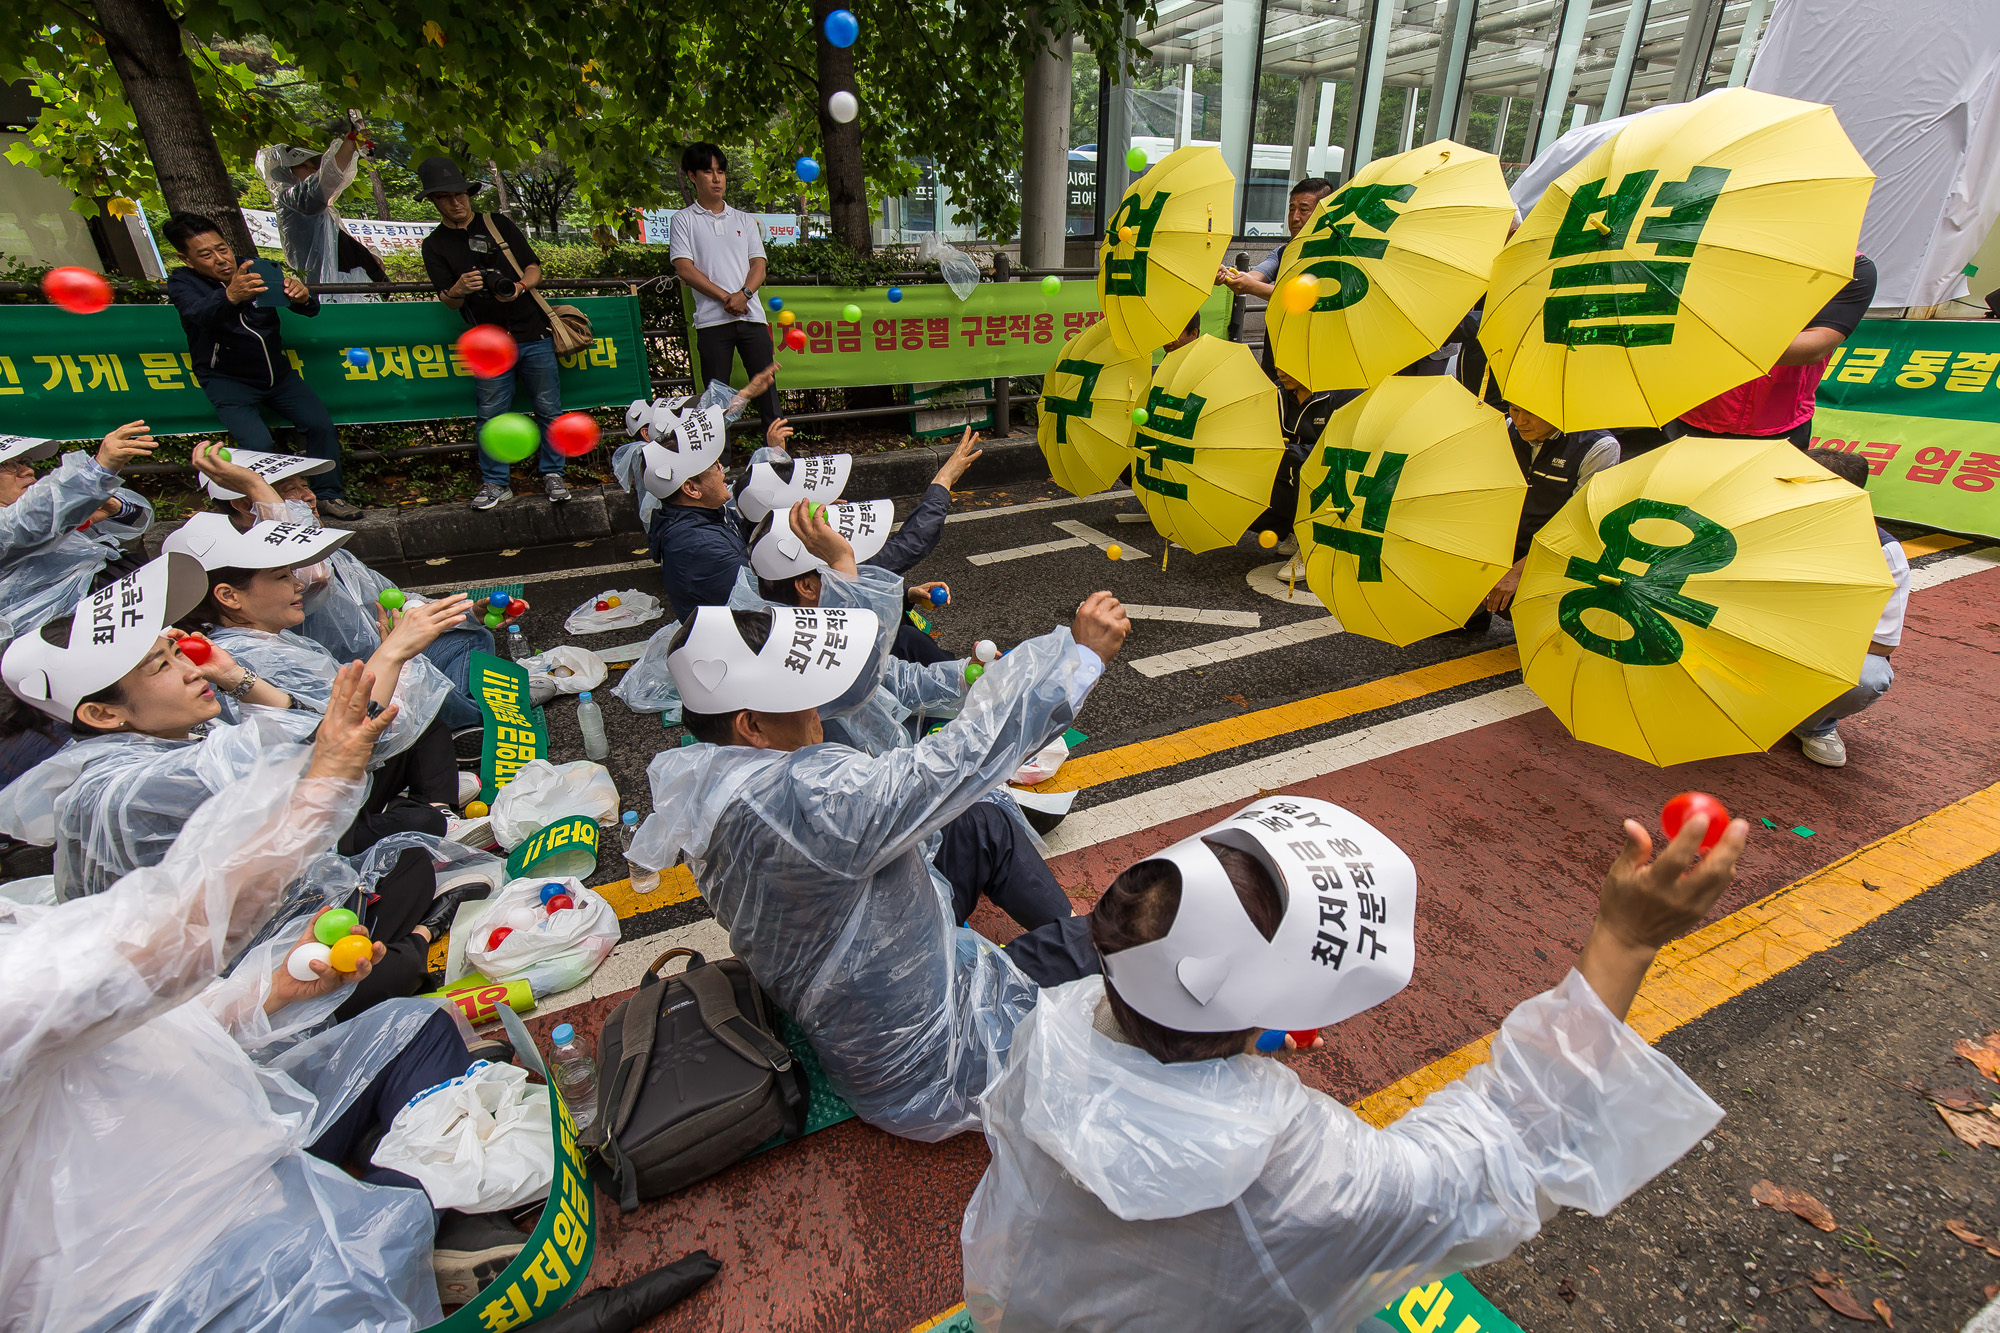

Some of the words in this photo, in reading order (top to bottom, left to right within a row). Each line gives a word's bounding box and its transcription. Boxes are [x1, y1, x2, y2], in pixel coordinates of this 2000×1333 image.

[769, 226, 794, 236] 진보당
[1106, 191, 1171, 297] 업
[1299, 184, 1417, 312] 종
[1544, 166, 1731, 348] 별
[32, 354, 130, 393] 가게
[767, 320, 861, 354] 저임금
[873, 317, 950, 351] 업종별
[960, 313, 1054, 347] 구분적용
[1895, 350, 2000, 393] 동결
[1044, 359, 1105, 444] 구
[1132, 386, 1207, 500] 분
[1309, 446, 1409, 583] 적
[1558, 498, 1737, 666] 용
[784, 608, 818, 675] 최저임금
[816, 608, 849, 670] 구분적용
[522, 820, 600, 869] 하라!!
[1286, 840, 1349, 972] 최저임금
[1326, 837, 1388, 961] 구분적용
[479, 1160, 590, 1333] 최저임금
